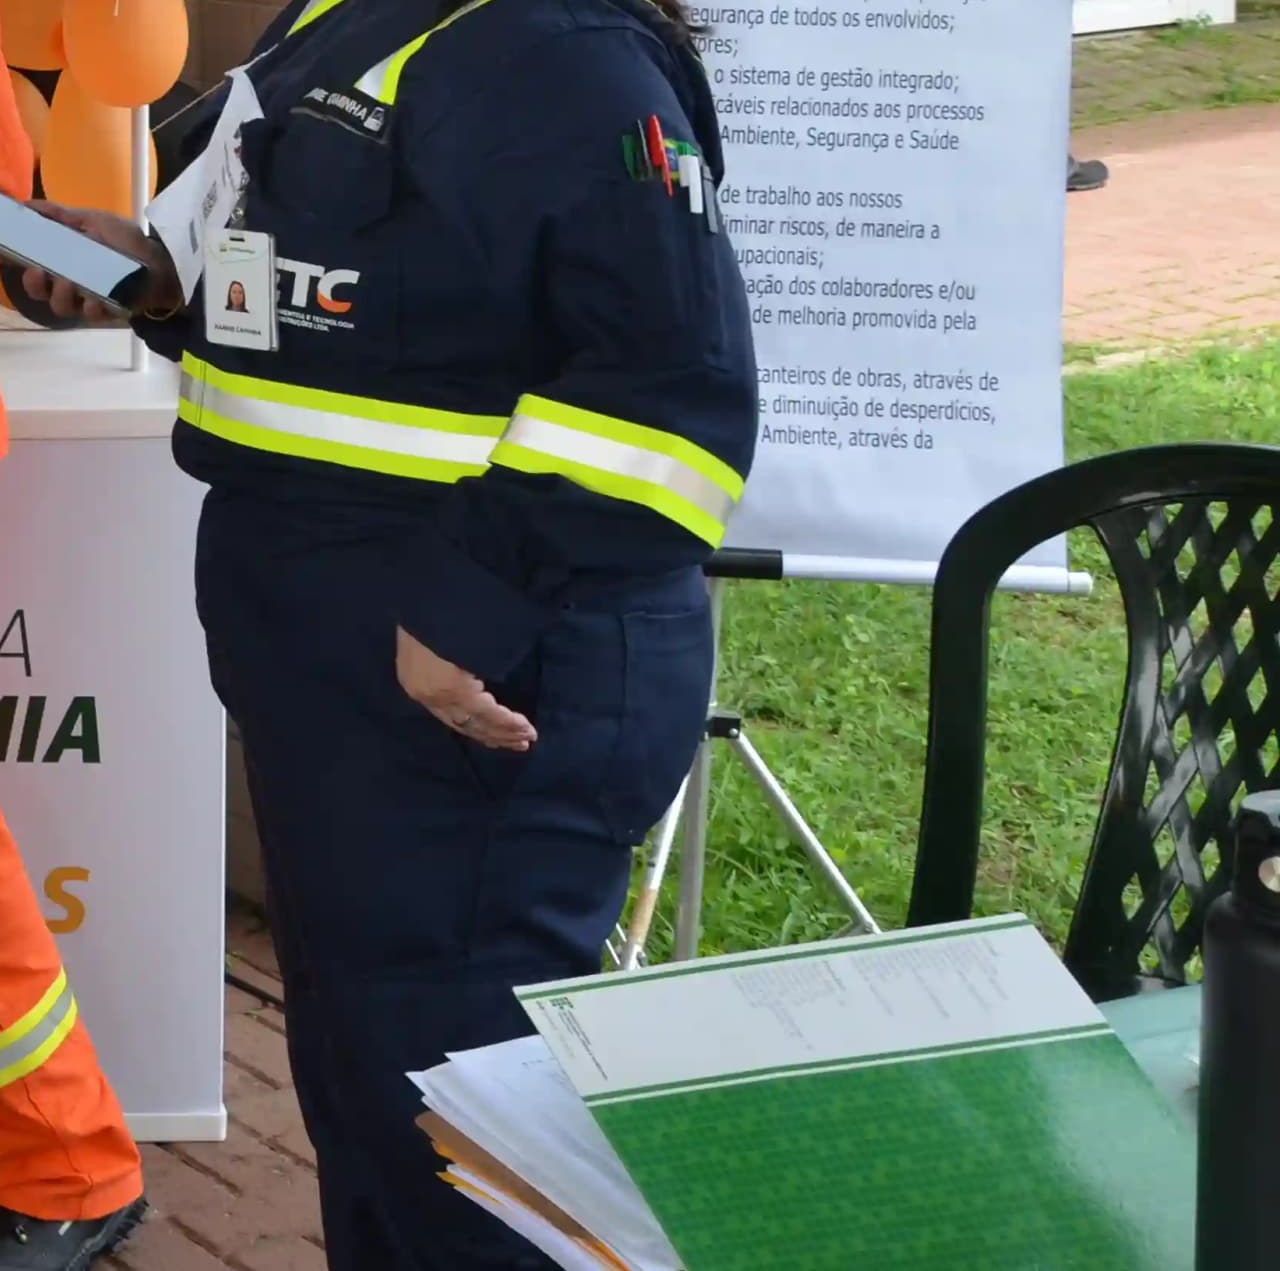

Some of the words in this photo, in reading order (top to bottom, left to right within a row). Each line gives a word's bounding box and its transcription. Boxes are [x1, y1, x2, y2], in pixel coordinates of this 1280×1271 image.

[686, 7, 764, 29] egurança
[770, 6, 789, 26] de
[794, 7, 837, 28] todos
[843, 11, 860, 28] os
[865, 8, 955, 33] envolvidos;
[696, 36, 739, 56] ores;
[714, 69, 724, 84] o
[730, 65, 790, 86] sistema
[797, 68, 815, 88] de
[821, 67, 872, 93] gestão
[878, 68, 959, 94] integrado;
[770, 97, 868, 119] relacionados
[874, 103, 900, 119] aos
[907, 104, 984, 124] processos
[722, 125, 799, 149] Ambiente,
[806, 127, 889, 152] Segurança
[895, 133, 905, 149] e
[910, 128, 959, 151] Saúde
[721, 184, 740, 203] de
[746, 185, 811, 206] trabalho
[817, 191, 843, 207] aos
[850, 190, 902, 209] nossos
[780, 217, 829, 239] riscos,
[836, 217, 855, 236] de
[861, 219, 927, 239] maneira
[931, 225, 940, 240] a
[735, 246, 824, 269] upacionais;
[744, 275, 783, 297] ação
[789, 276, 816, 295] dos
[822, 279, 933, 300] colaboradores
[939, 281, 975, 302] e/ou
[752, 305, 772, 324] de
[778, 306, 846, 326] melhoria
[853, 309, 938, 332] promovida
[944, 311, 976, 332] pela
[832, 366, 852, 386] de
[857, 369, 907, 392] obras,
[913, 367, 973, 391] através
[978, 371, 999, 392] de
[773, 395, 858, 421] diminuição
[865, 398, 885, 418] de
[890, 398, 995, 425] desperdícios,
[761, 424, 842, 450] Ambiente,
[849, 427, 908, 450] através
[913, 430, 933, 450] da
